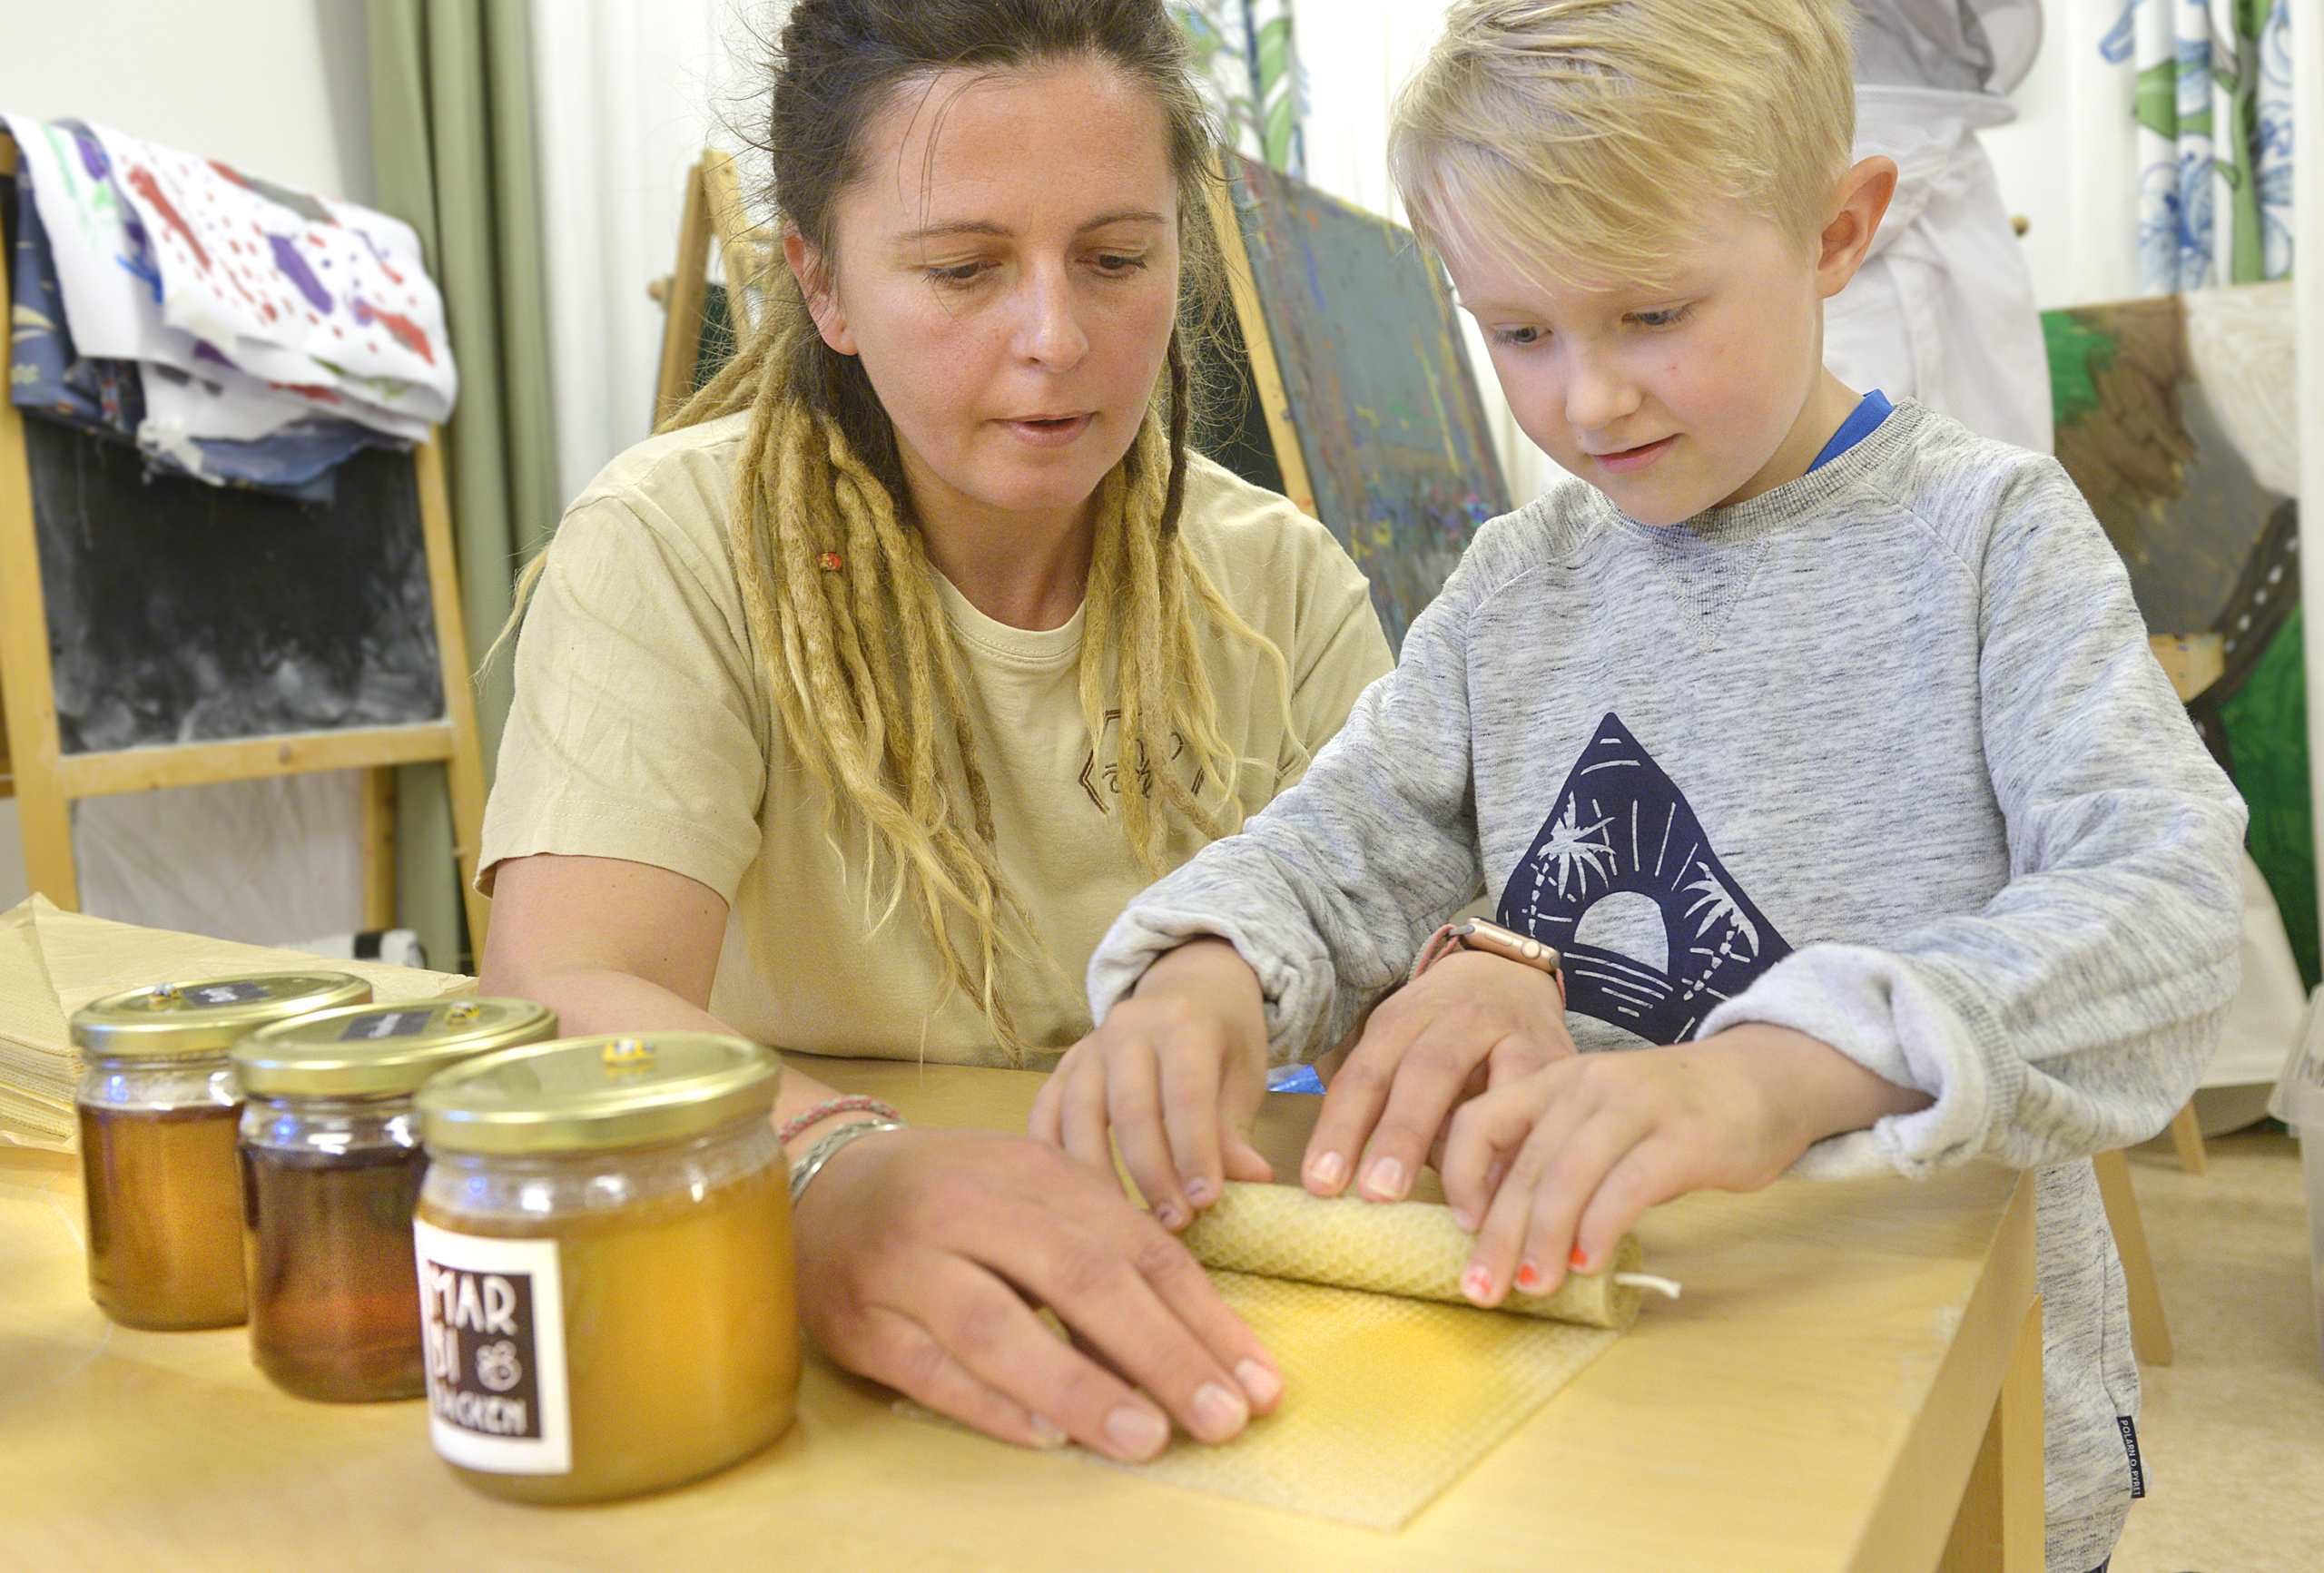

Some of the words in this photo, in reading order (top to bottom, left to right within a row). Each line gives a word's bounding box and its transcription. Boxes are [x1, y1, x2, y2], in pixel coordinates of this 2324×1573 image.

[430, 1263, 518, 1336] MAR
[2121, 1420, 2135, 1456] POLARN
[2130, 1459, 2138, 1467] O
[2132, 1470, 2141, 1496] PYRET
